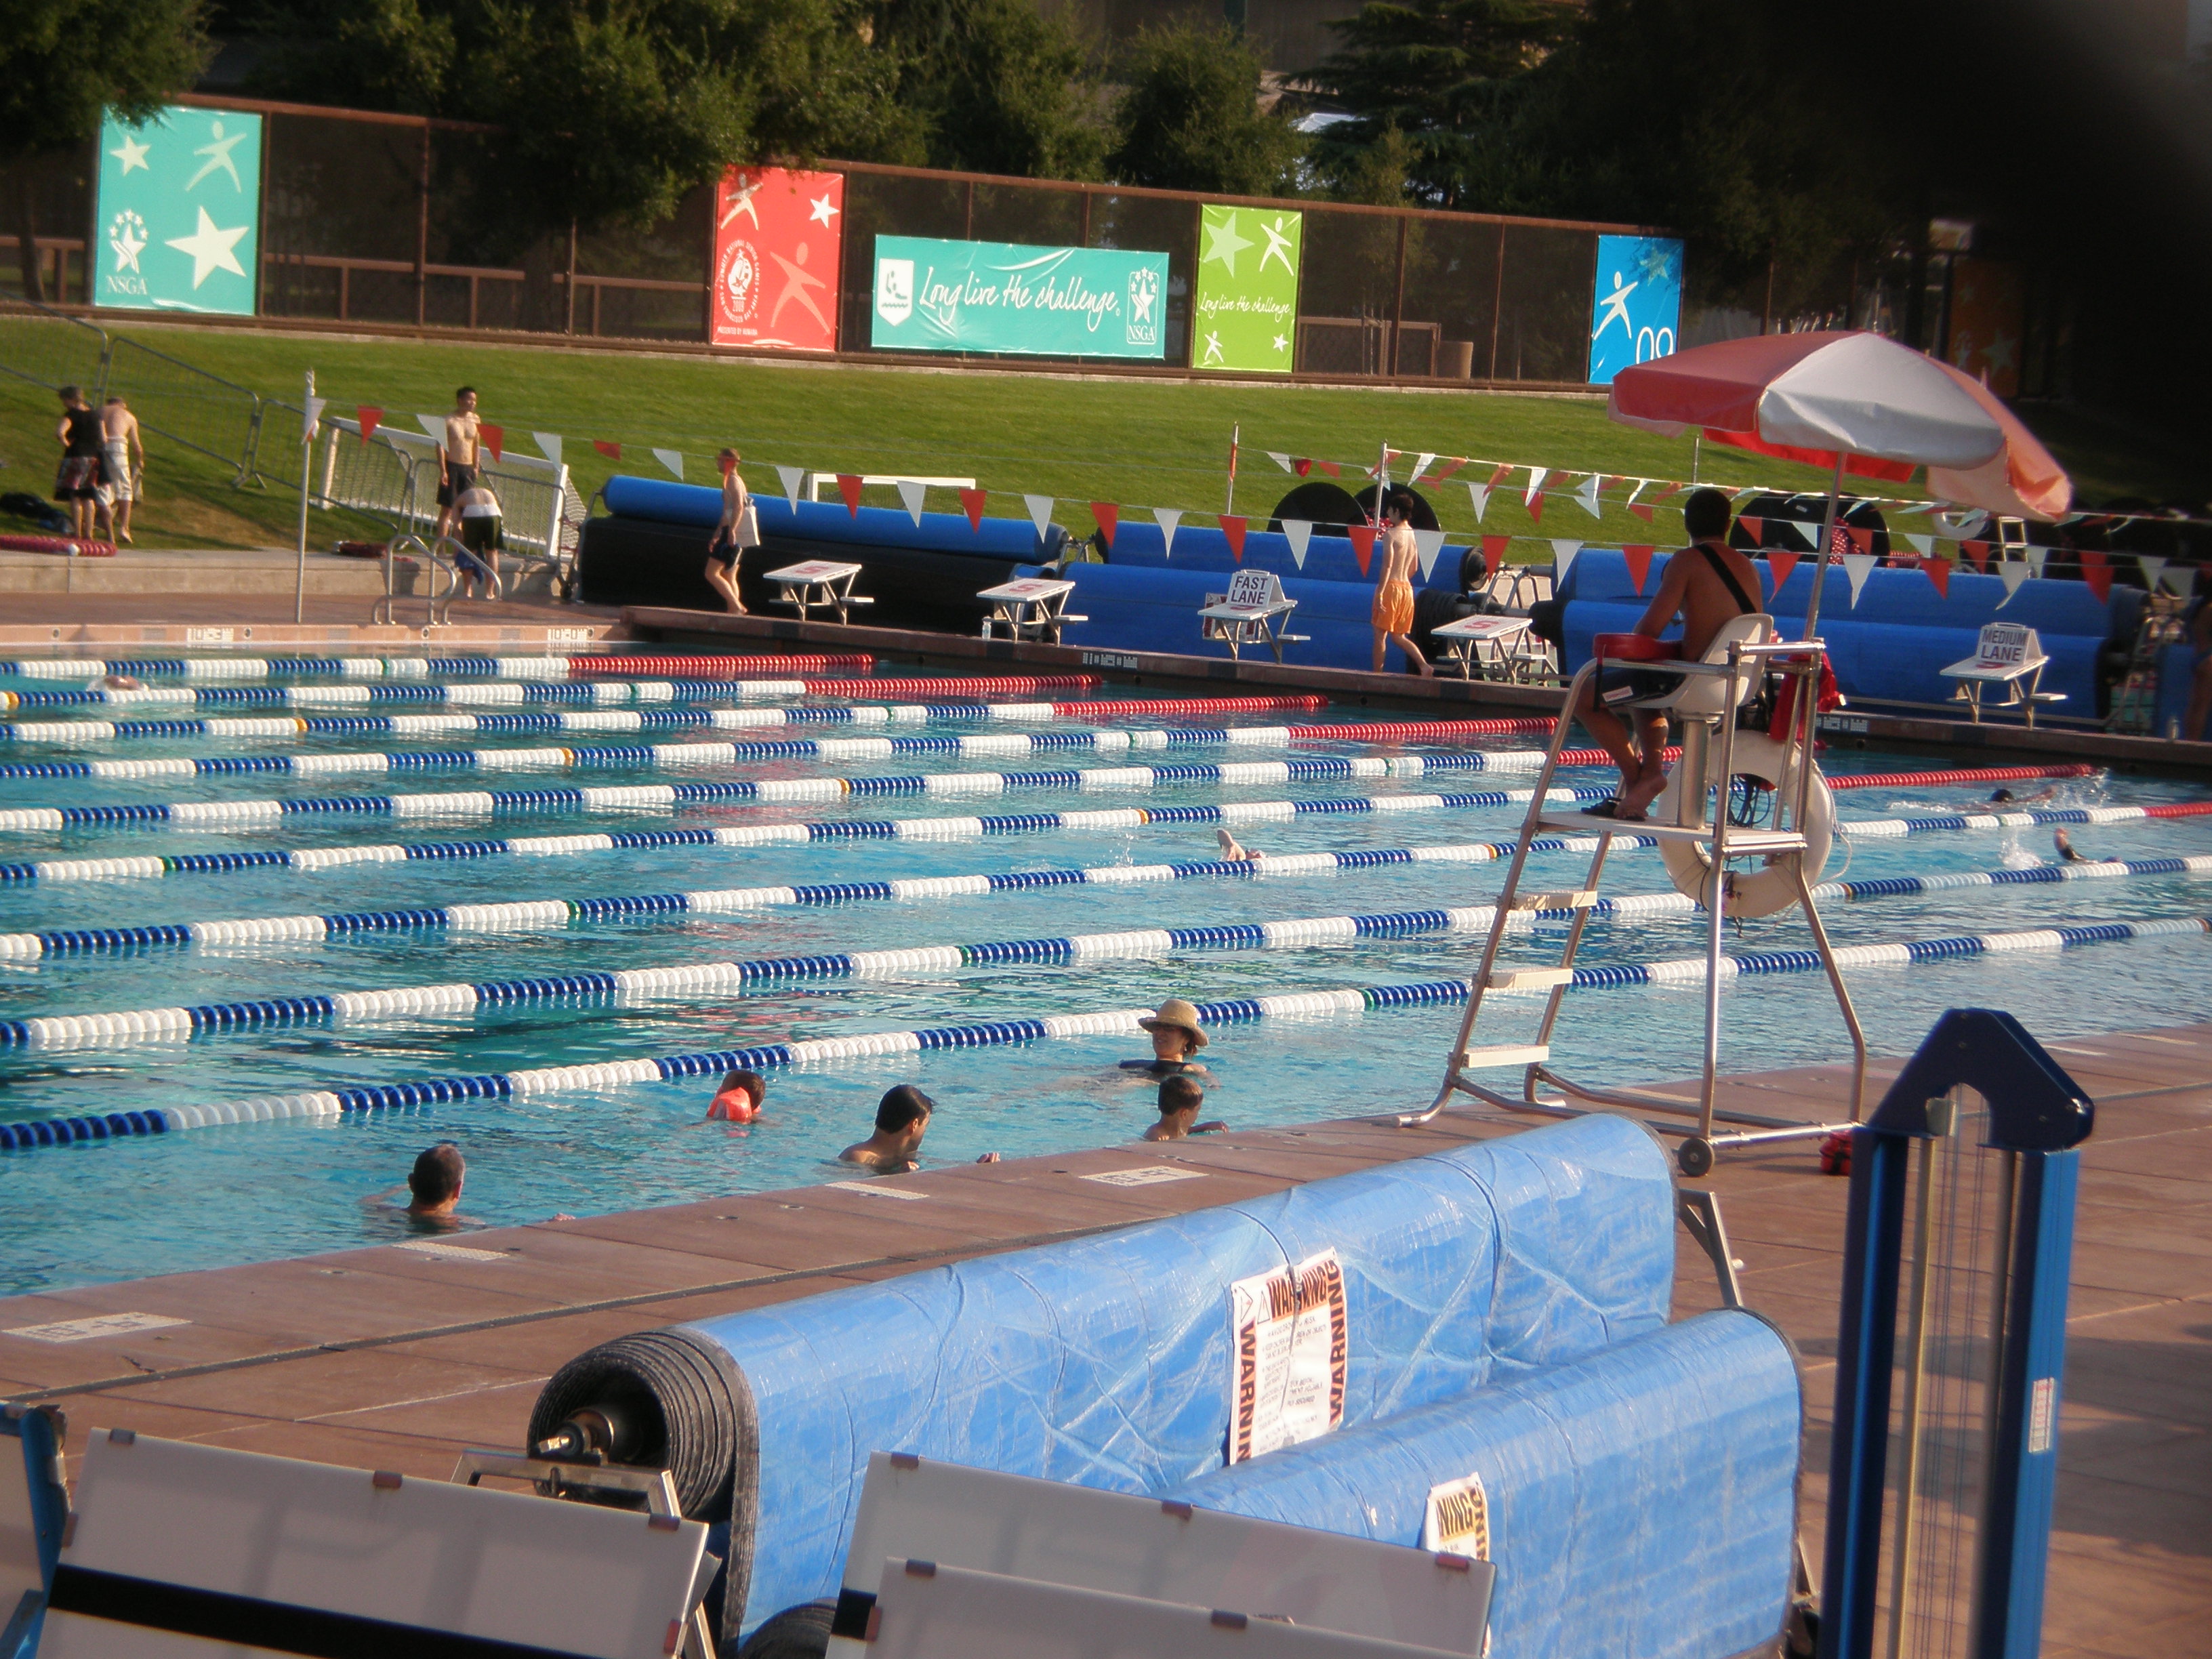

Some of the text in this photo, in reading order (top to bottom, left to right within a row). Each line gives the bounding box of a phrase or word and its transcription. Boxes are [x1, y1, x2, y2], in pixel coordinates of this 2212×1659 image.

[106, 275, 148, 295] NSGA
[920, 266, 963, 325] Long
[964, 271, 1000, 306] live
[1002, 274, 1032, 309] the
[1200, 291, 1219, 319] Long
[1219, 294, 1235, 310] live
[1236, 295, 1250, 312] the
[1128, 323, 1156, 342] NSGA
[1234, 575, 1268, 591] FAST
[1230, 588, 1266, 605] LANE
[1982, 629, 2027, 647] MEDIUM
[1980, 644, 2022, 662] LANE
[1328, 1258, 1347, 1425] WARNING
